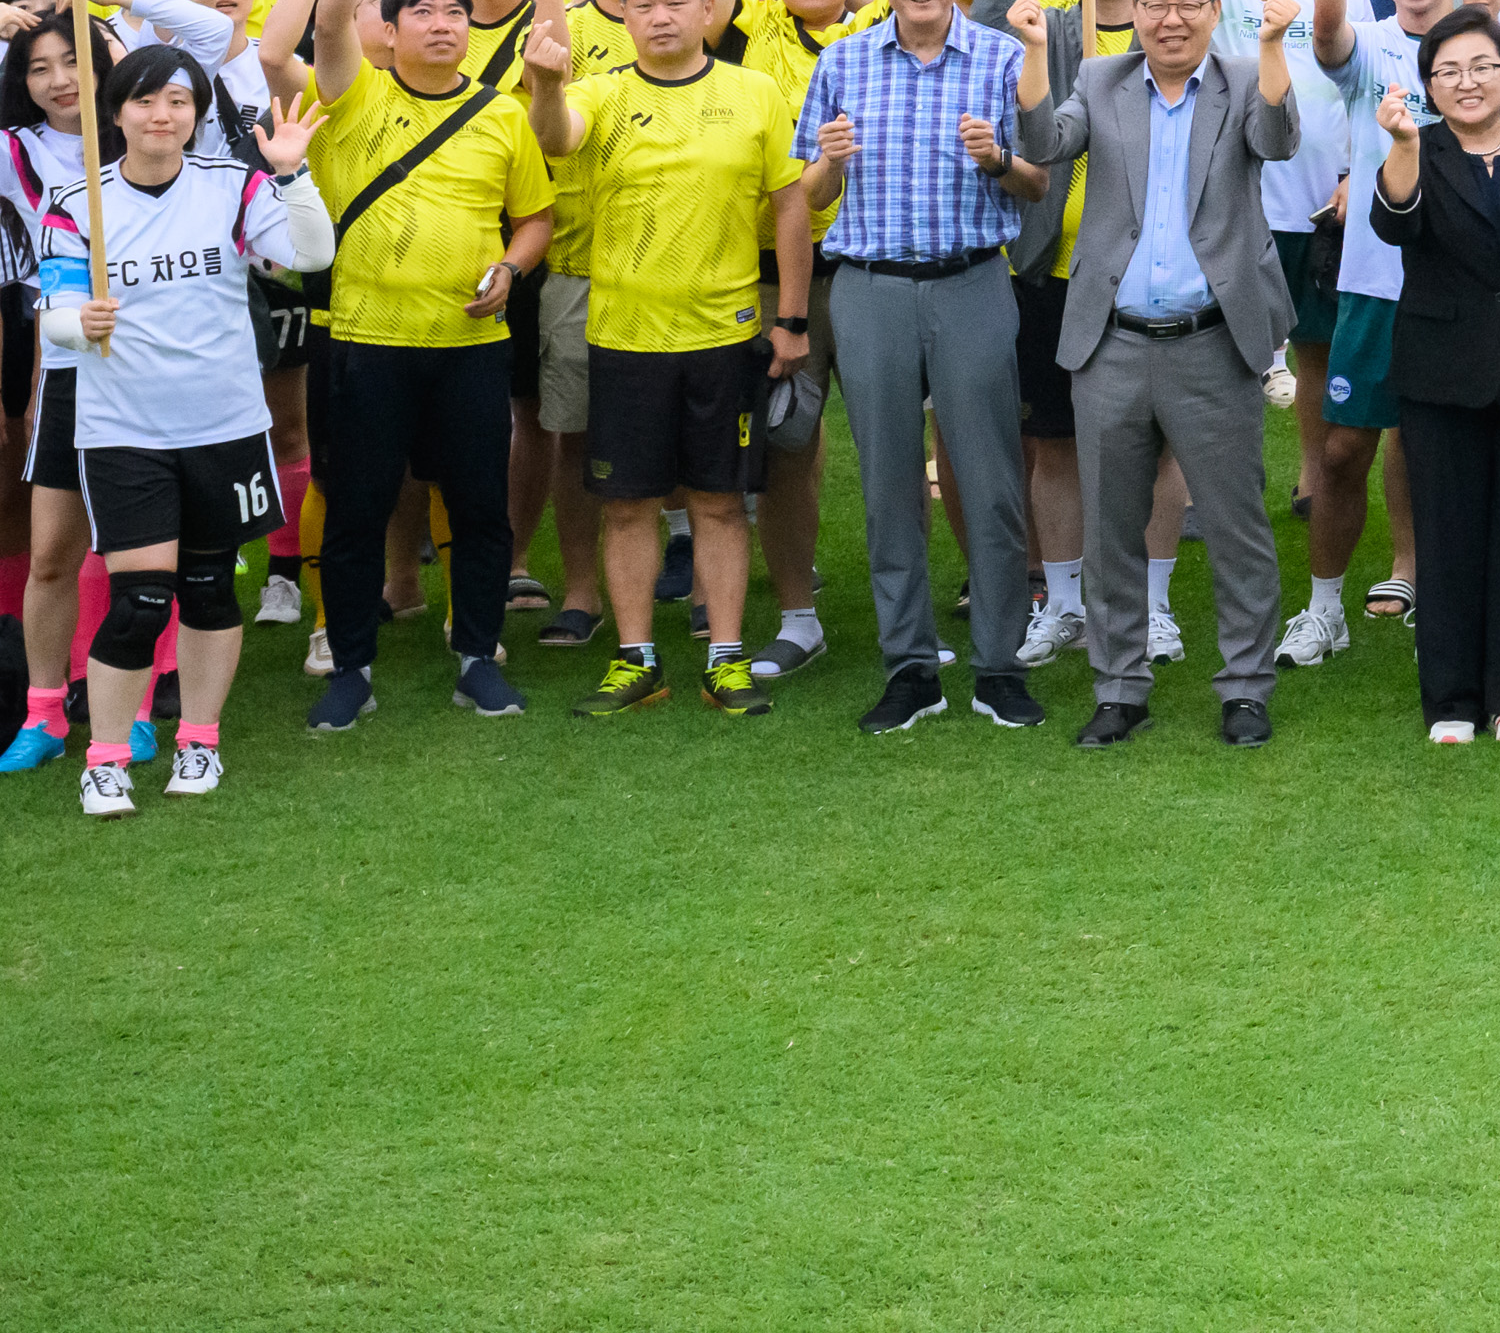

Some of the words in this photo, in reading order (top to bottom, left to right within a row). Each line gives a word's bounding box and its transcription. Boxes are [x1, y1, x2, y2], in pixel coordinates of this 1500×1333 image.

[701, 108, 735, 117] KHWA
[150, 247, 222, 285] 차오름
[233, 471, 270, 524] 16
